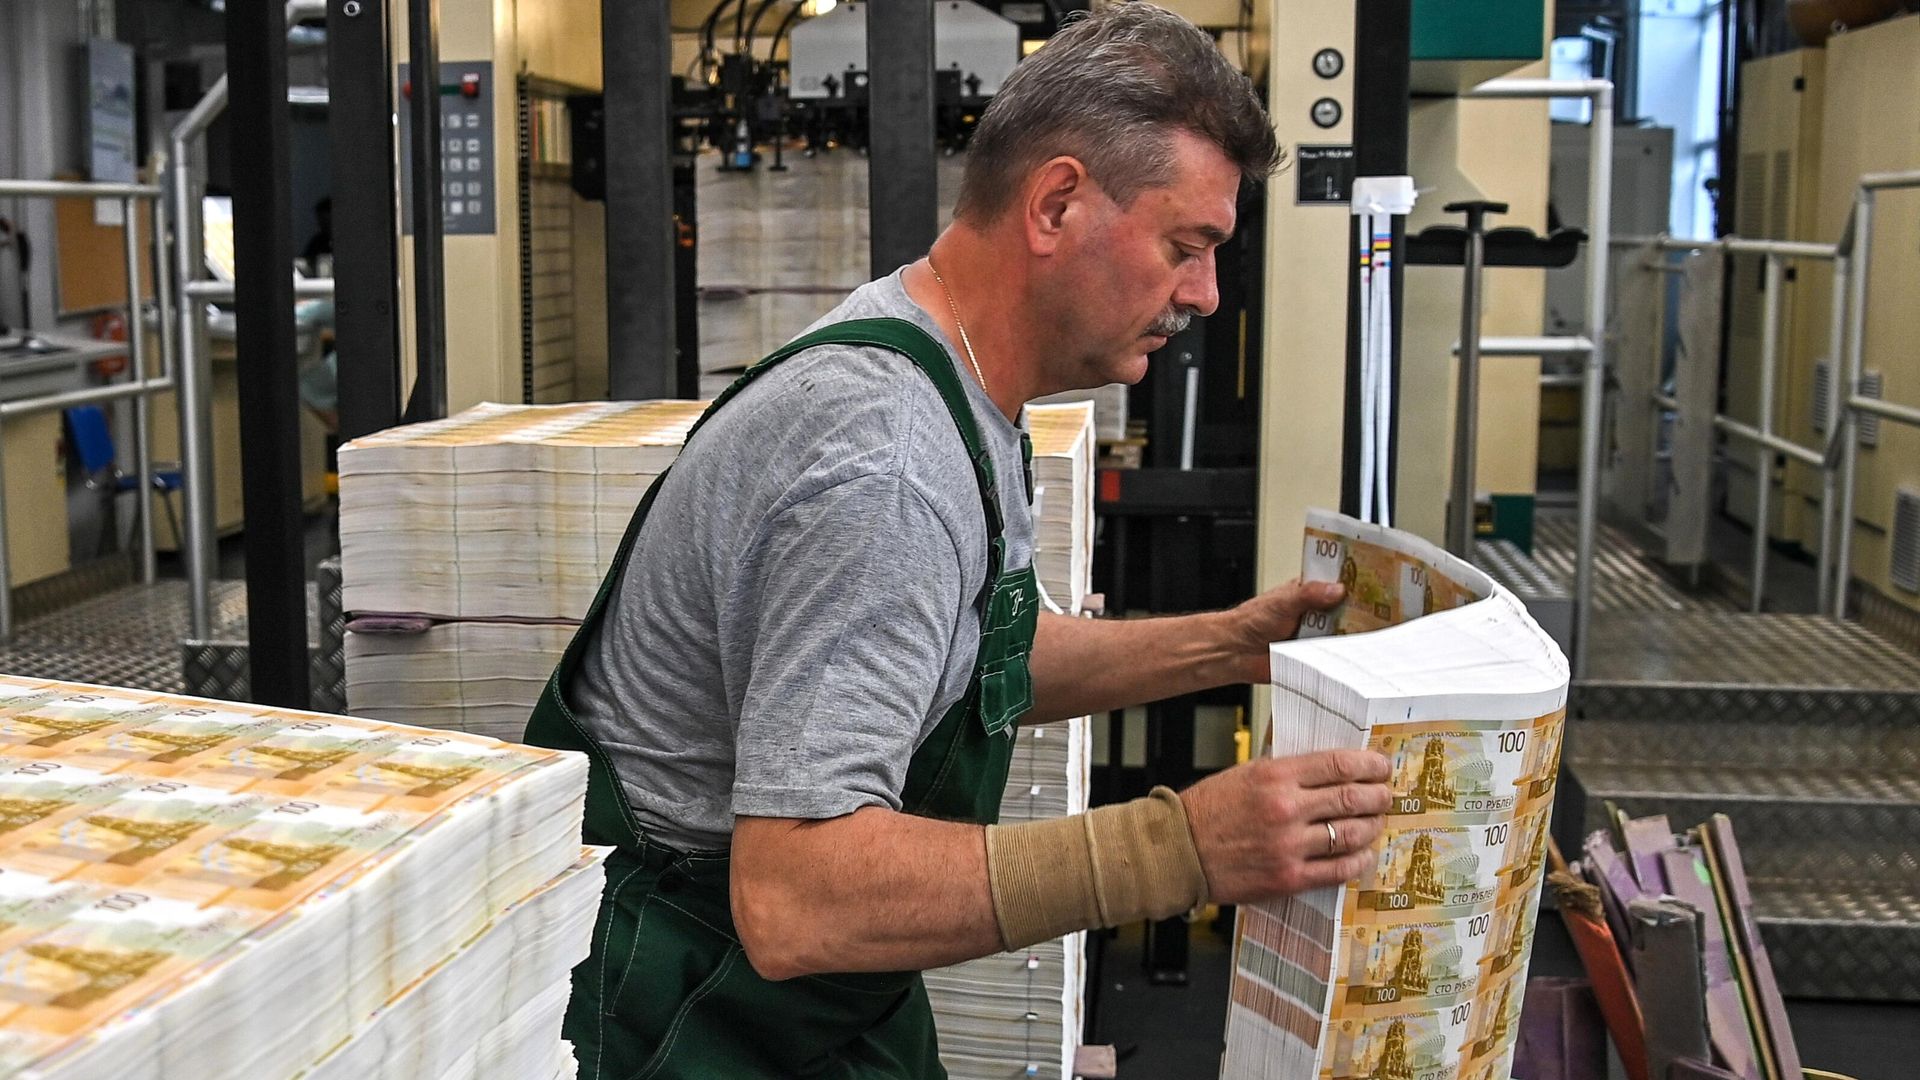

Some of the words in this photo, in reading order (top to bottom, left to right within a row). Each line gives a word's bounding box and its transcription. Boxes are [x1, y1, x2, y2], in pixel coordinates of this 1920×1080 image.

[1315, 539, 1338, 559] 100
[1498, 731, 1526, 754] 100
[13, 762, 62, 776] 100
[141, 781, 188, 794] 100
[273, 801, 320, 815] 100
[1400, 798, 1420, 813] 100
[1464, 800, 1483, 810] СТО
[1484, 823, 1508, 847] 100
[94, 892, 150, 912] 100
[1388, 893, 1409, 908] 100
[1452, 893, 1469, 904] СТО
[1468, 913, 1490, 938] 100
[1377, 988, 1396, 1001] 100
[1434, 983, 1452, 994] СТО
[1451, 1001, 1471, 1026] 100
[1420, 1072, 1435, 1080] СТО
